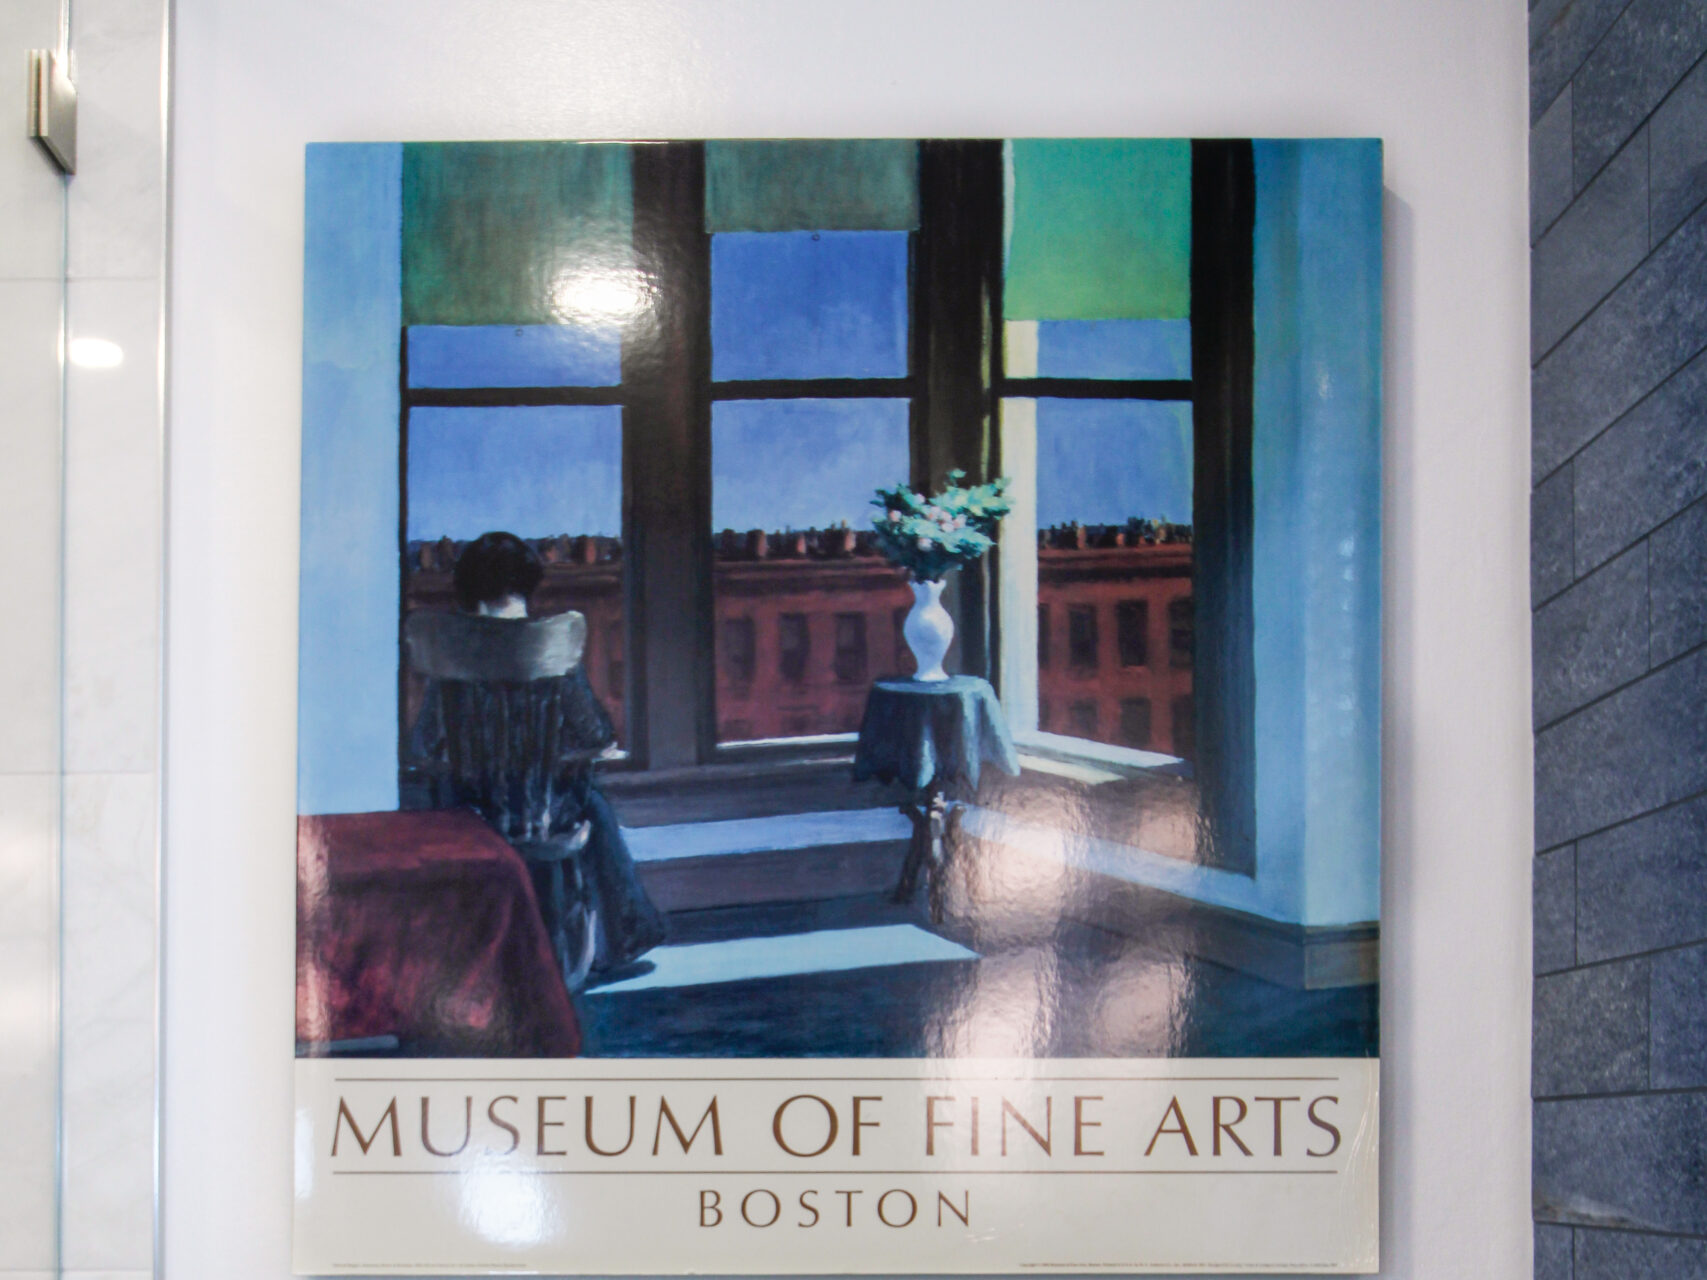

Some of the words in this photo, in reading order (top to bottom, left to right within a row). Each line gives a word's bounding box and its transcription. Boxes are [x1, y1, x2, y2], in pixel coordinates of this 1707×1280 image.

[330, 1095, 724, 1157] MUSEUM
[771, 1094, 883, 1158] OF
[925, 1095, 1105, 1157] FINE
[1143, 1095, 1342, 1158] ARTS
[698, 1188, 970, 1228] BOSTON
